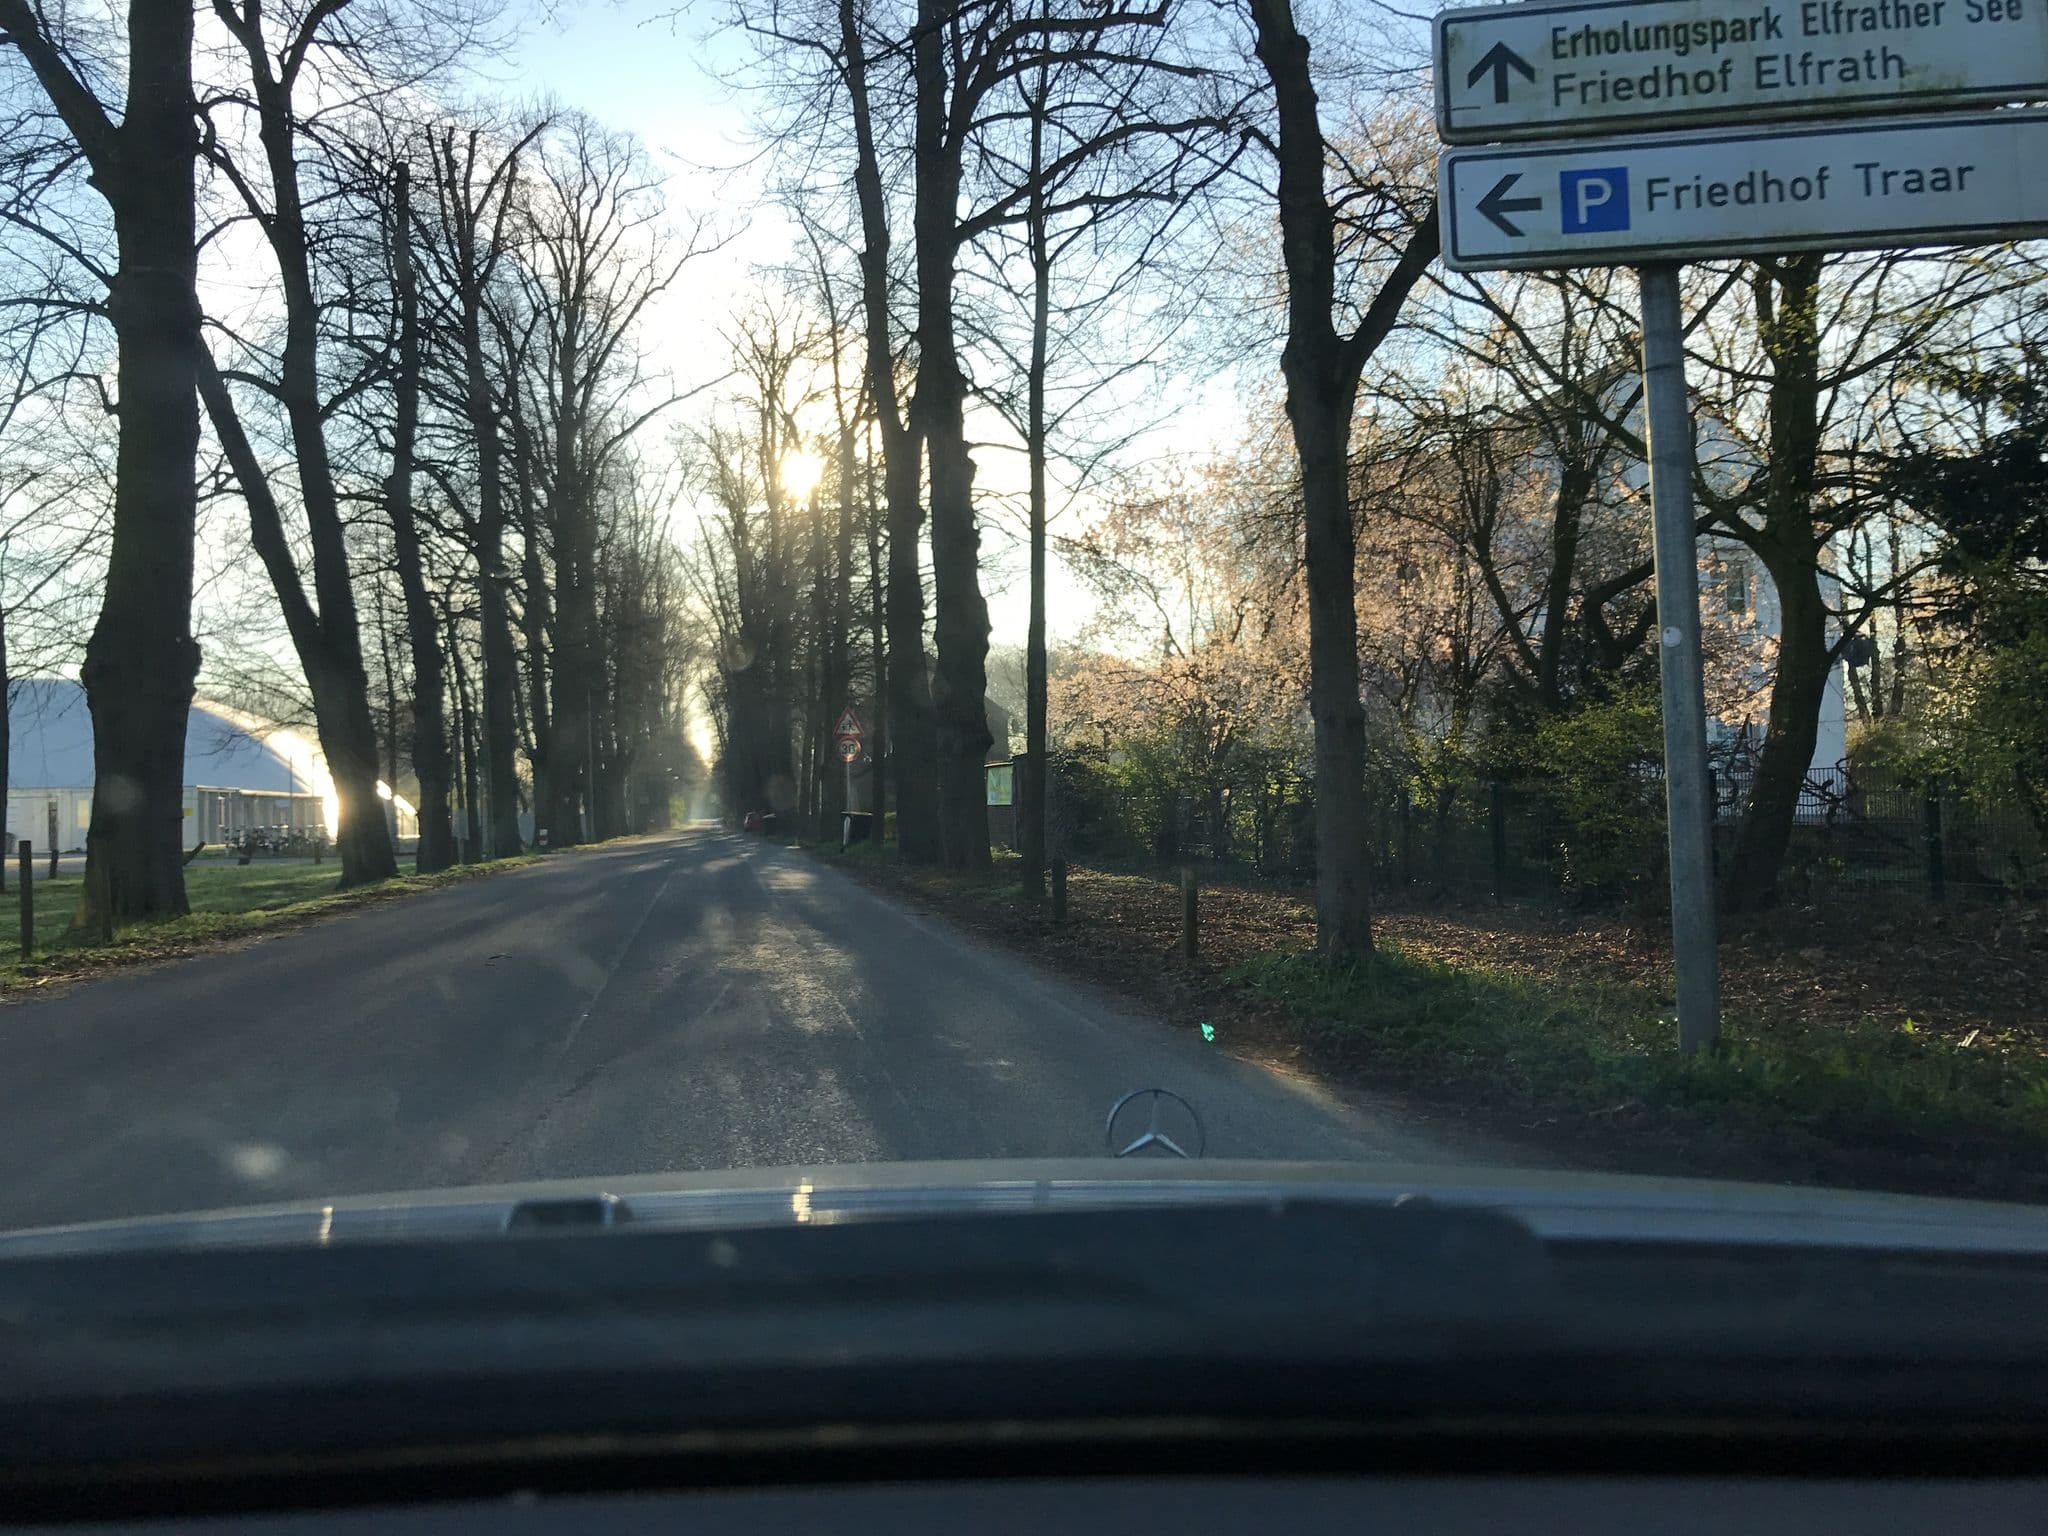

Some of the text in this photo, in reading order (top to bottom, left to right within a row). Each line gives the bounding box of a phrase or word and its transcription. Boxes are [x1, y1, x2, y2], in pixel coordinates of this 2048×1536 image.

[1552, 0, 2024, 57] Erholungspark Elfrather See
[1553, 46, 1905, 107] Friedhof Elfrath
[1576, 161, 1976, 225] P Friedhof Traar
